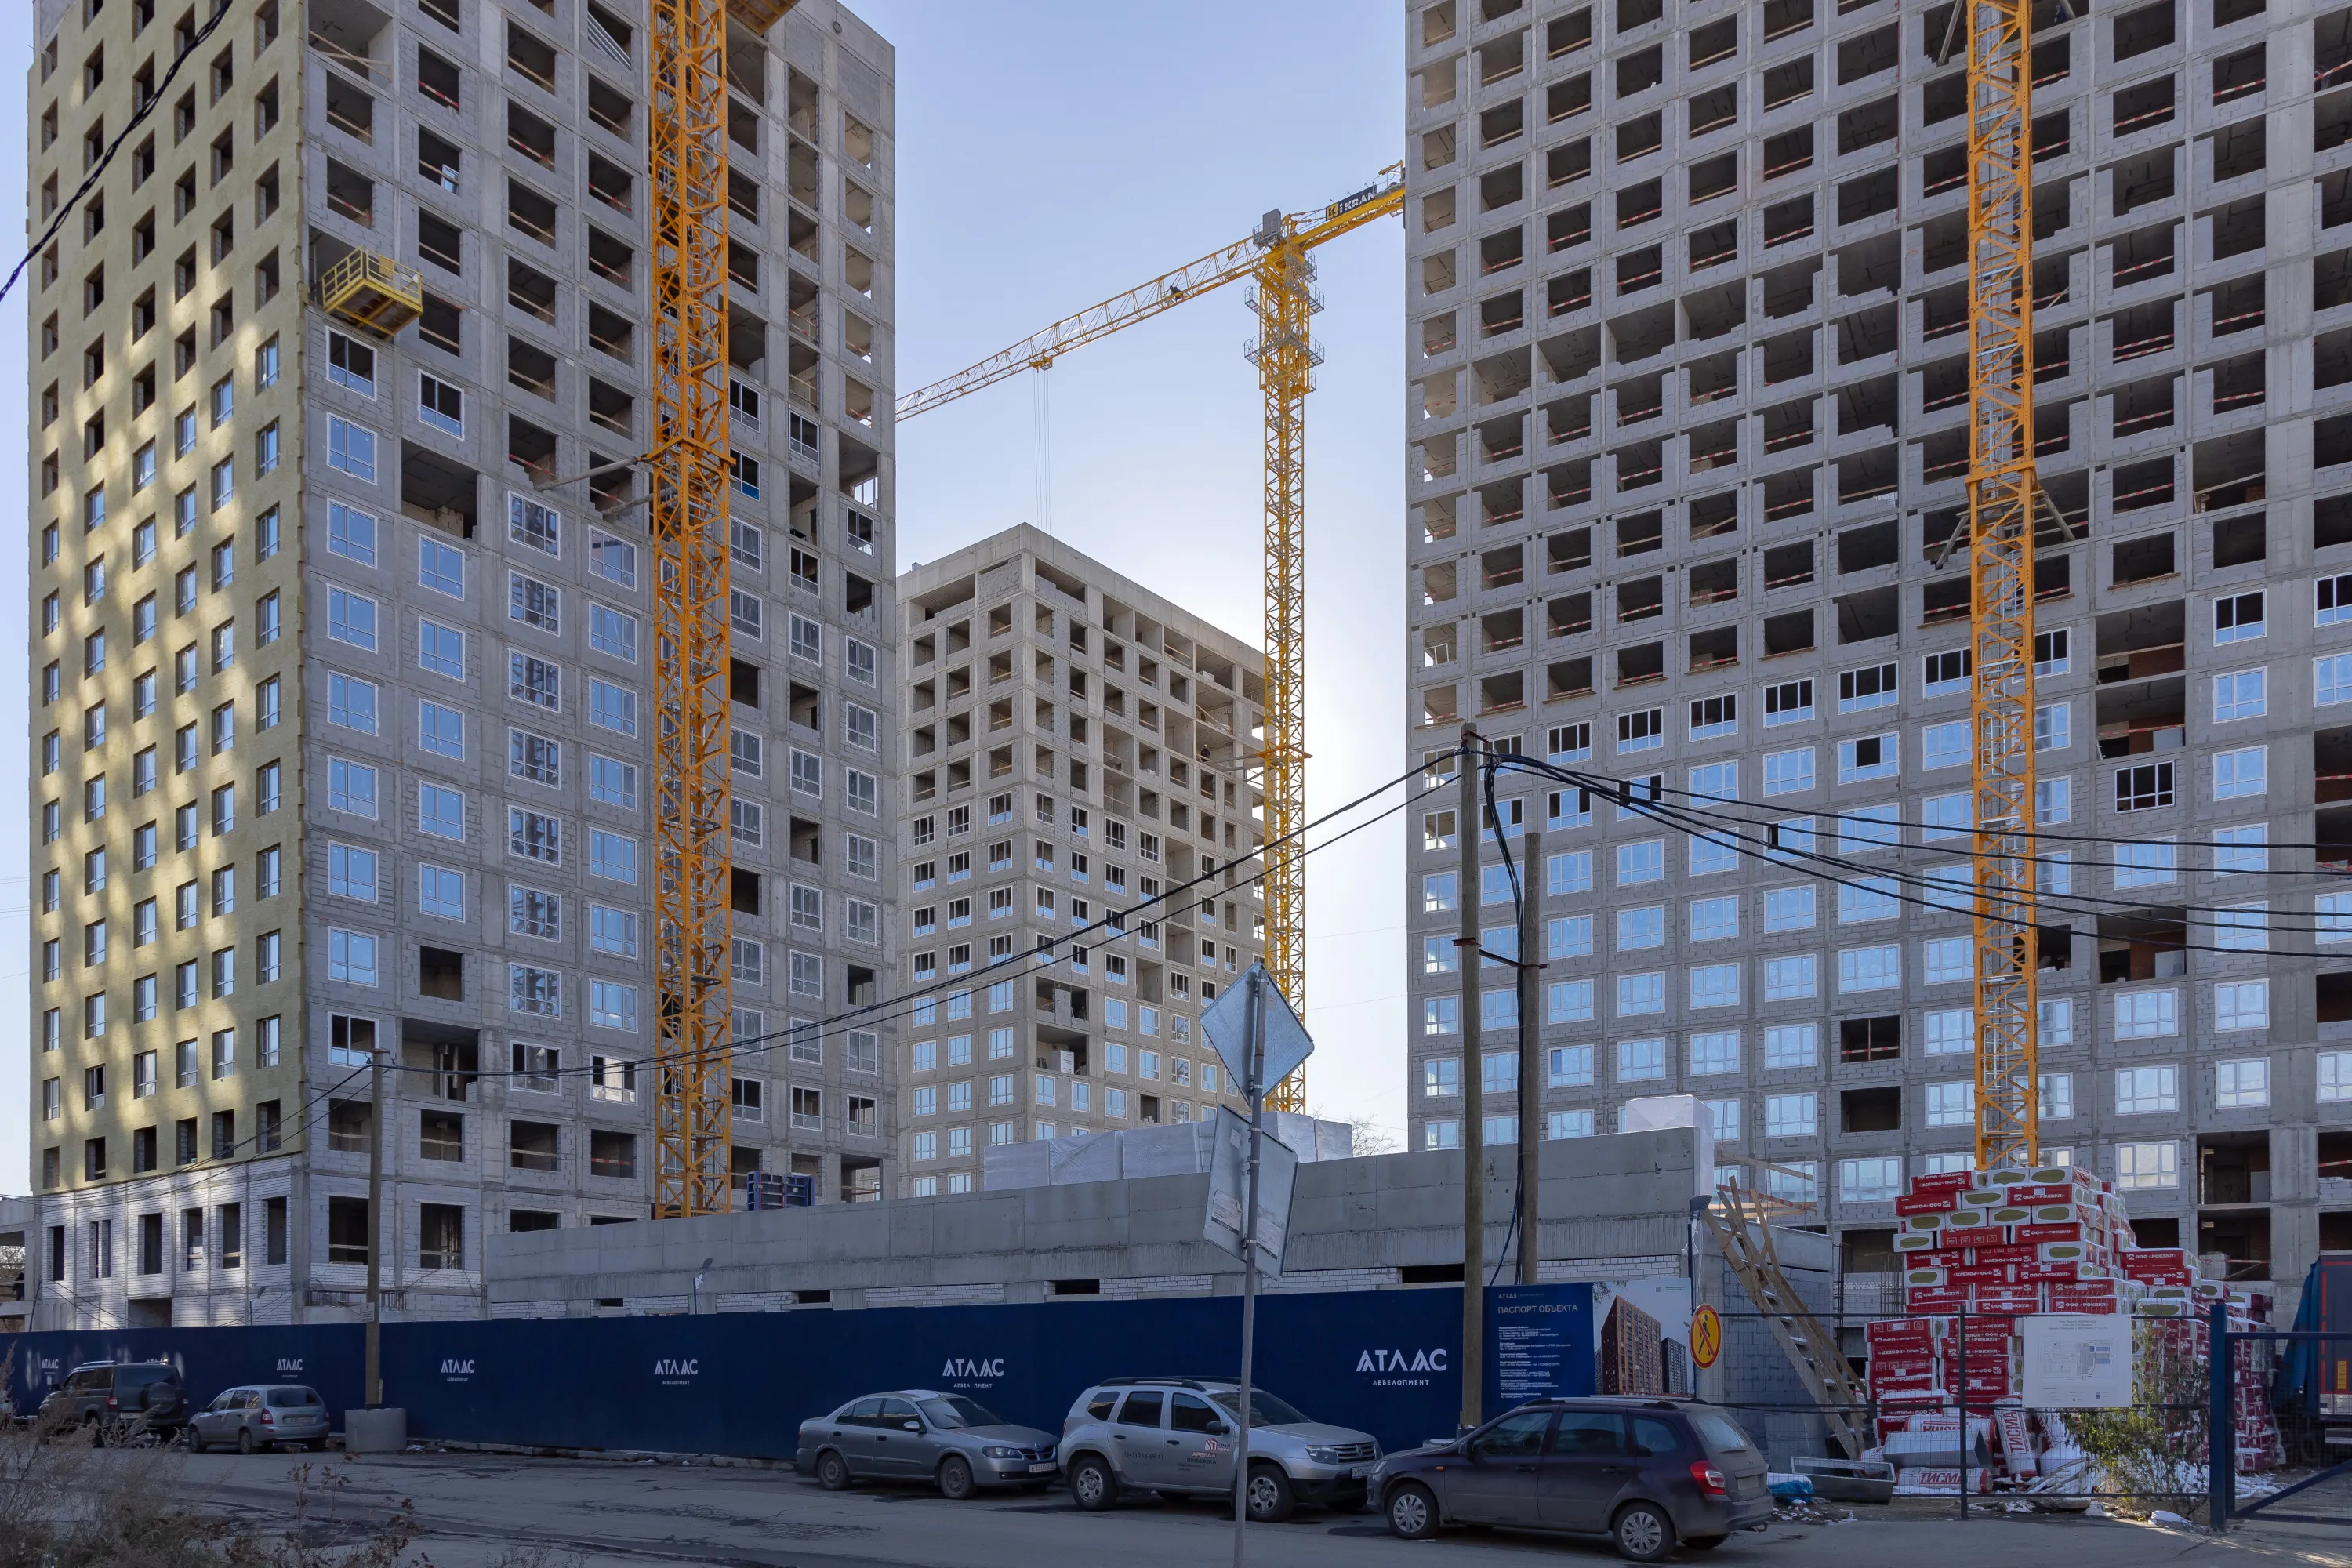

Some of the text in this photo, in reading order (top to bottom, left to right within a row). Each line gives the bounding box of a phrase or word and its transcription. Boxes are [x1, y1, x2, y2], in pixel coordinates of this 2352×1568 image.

[1498, 1304, 1578, 1314] ПАСПОРТ ОБЪЕКТА
[41, 1359, 60, 1369] АТЛАС
[276, 1359, 303, 1371] АТЛАС
[441, 1359, 475, 1373] АТЛАС
[654, 1359, 699, 1375] АТЛАС
[942, 1358, 1004, 1377] АТЛАС
[1356, 1348, 1447, 1372] АТЛАС
[2003, 1412, 2024, 1453] ТИСМА
